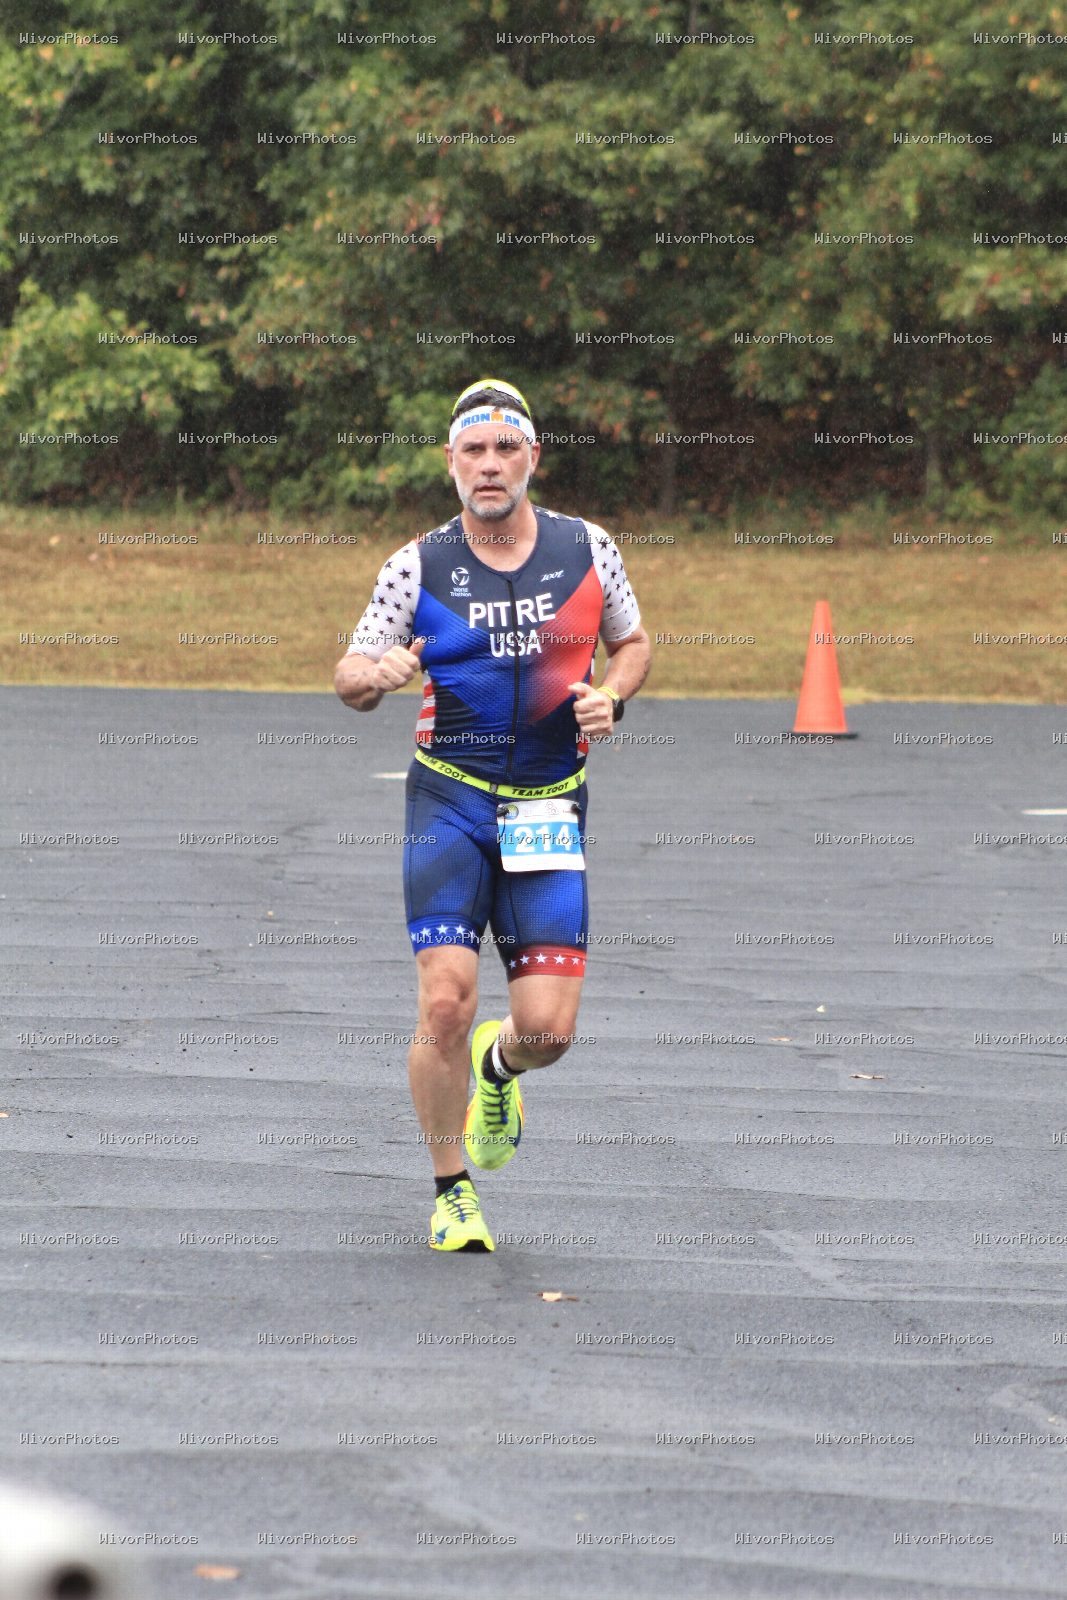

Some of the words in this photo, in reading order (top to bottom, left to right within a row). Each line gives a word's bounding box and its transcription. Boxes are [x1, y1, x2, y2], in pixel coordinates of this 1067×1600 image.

[461, 410, 520, 428] IRONMAN
[469, 592, 556, 629] PITRE
[490, 629, 542, 658] USA
[438, 763, 468, 781] ZOOT
[512, 788, 544, 797] TEAM
[546, 782, 569, 795] ZOOT
[513, 824, 572, 853] 214
